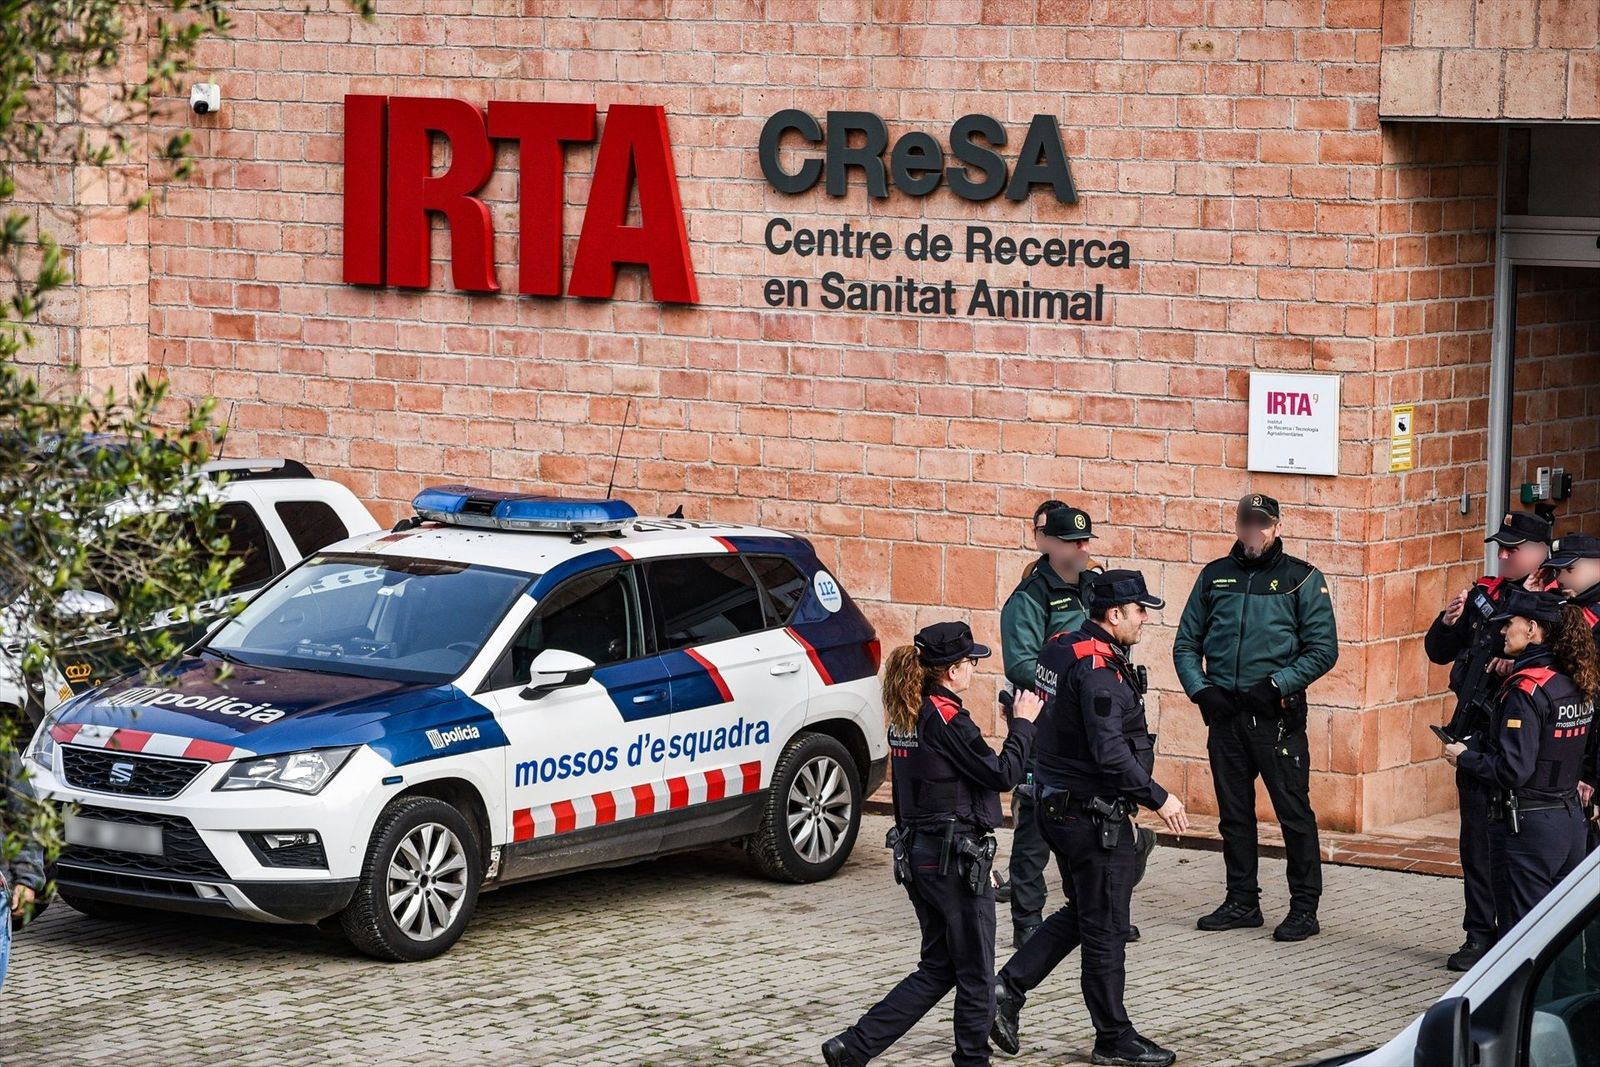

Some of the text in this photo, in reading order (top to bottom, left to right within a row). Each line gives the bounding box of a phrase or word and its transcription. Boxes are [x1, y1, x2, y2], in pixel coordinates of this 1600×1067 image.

[759, 108, 1078, 203] CReSA
[344, 94, 700, 304] IRTA
[764, 217, 1131, 269] Centre de Recerca
[764, 271, 1104, 321] en Sanitat Animal
[1267, 391, 1312, 416] IRTA
[818, 581, 836, 596] 112
[1035, 663, 1058, 687] POLICIA
[142, 693, 286, 724] policia
[441, 724, 480, 746] policia
[515, 717, 770, 788] mossos d'esquadra
